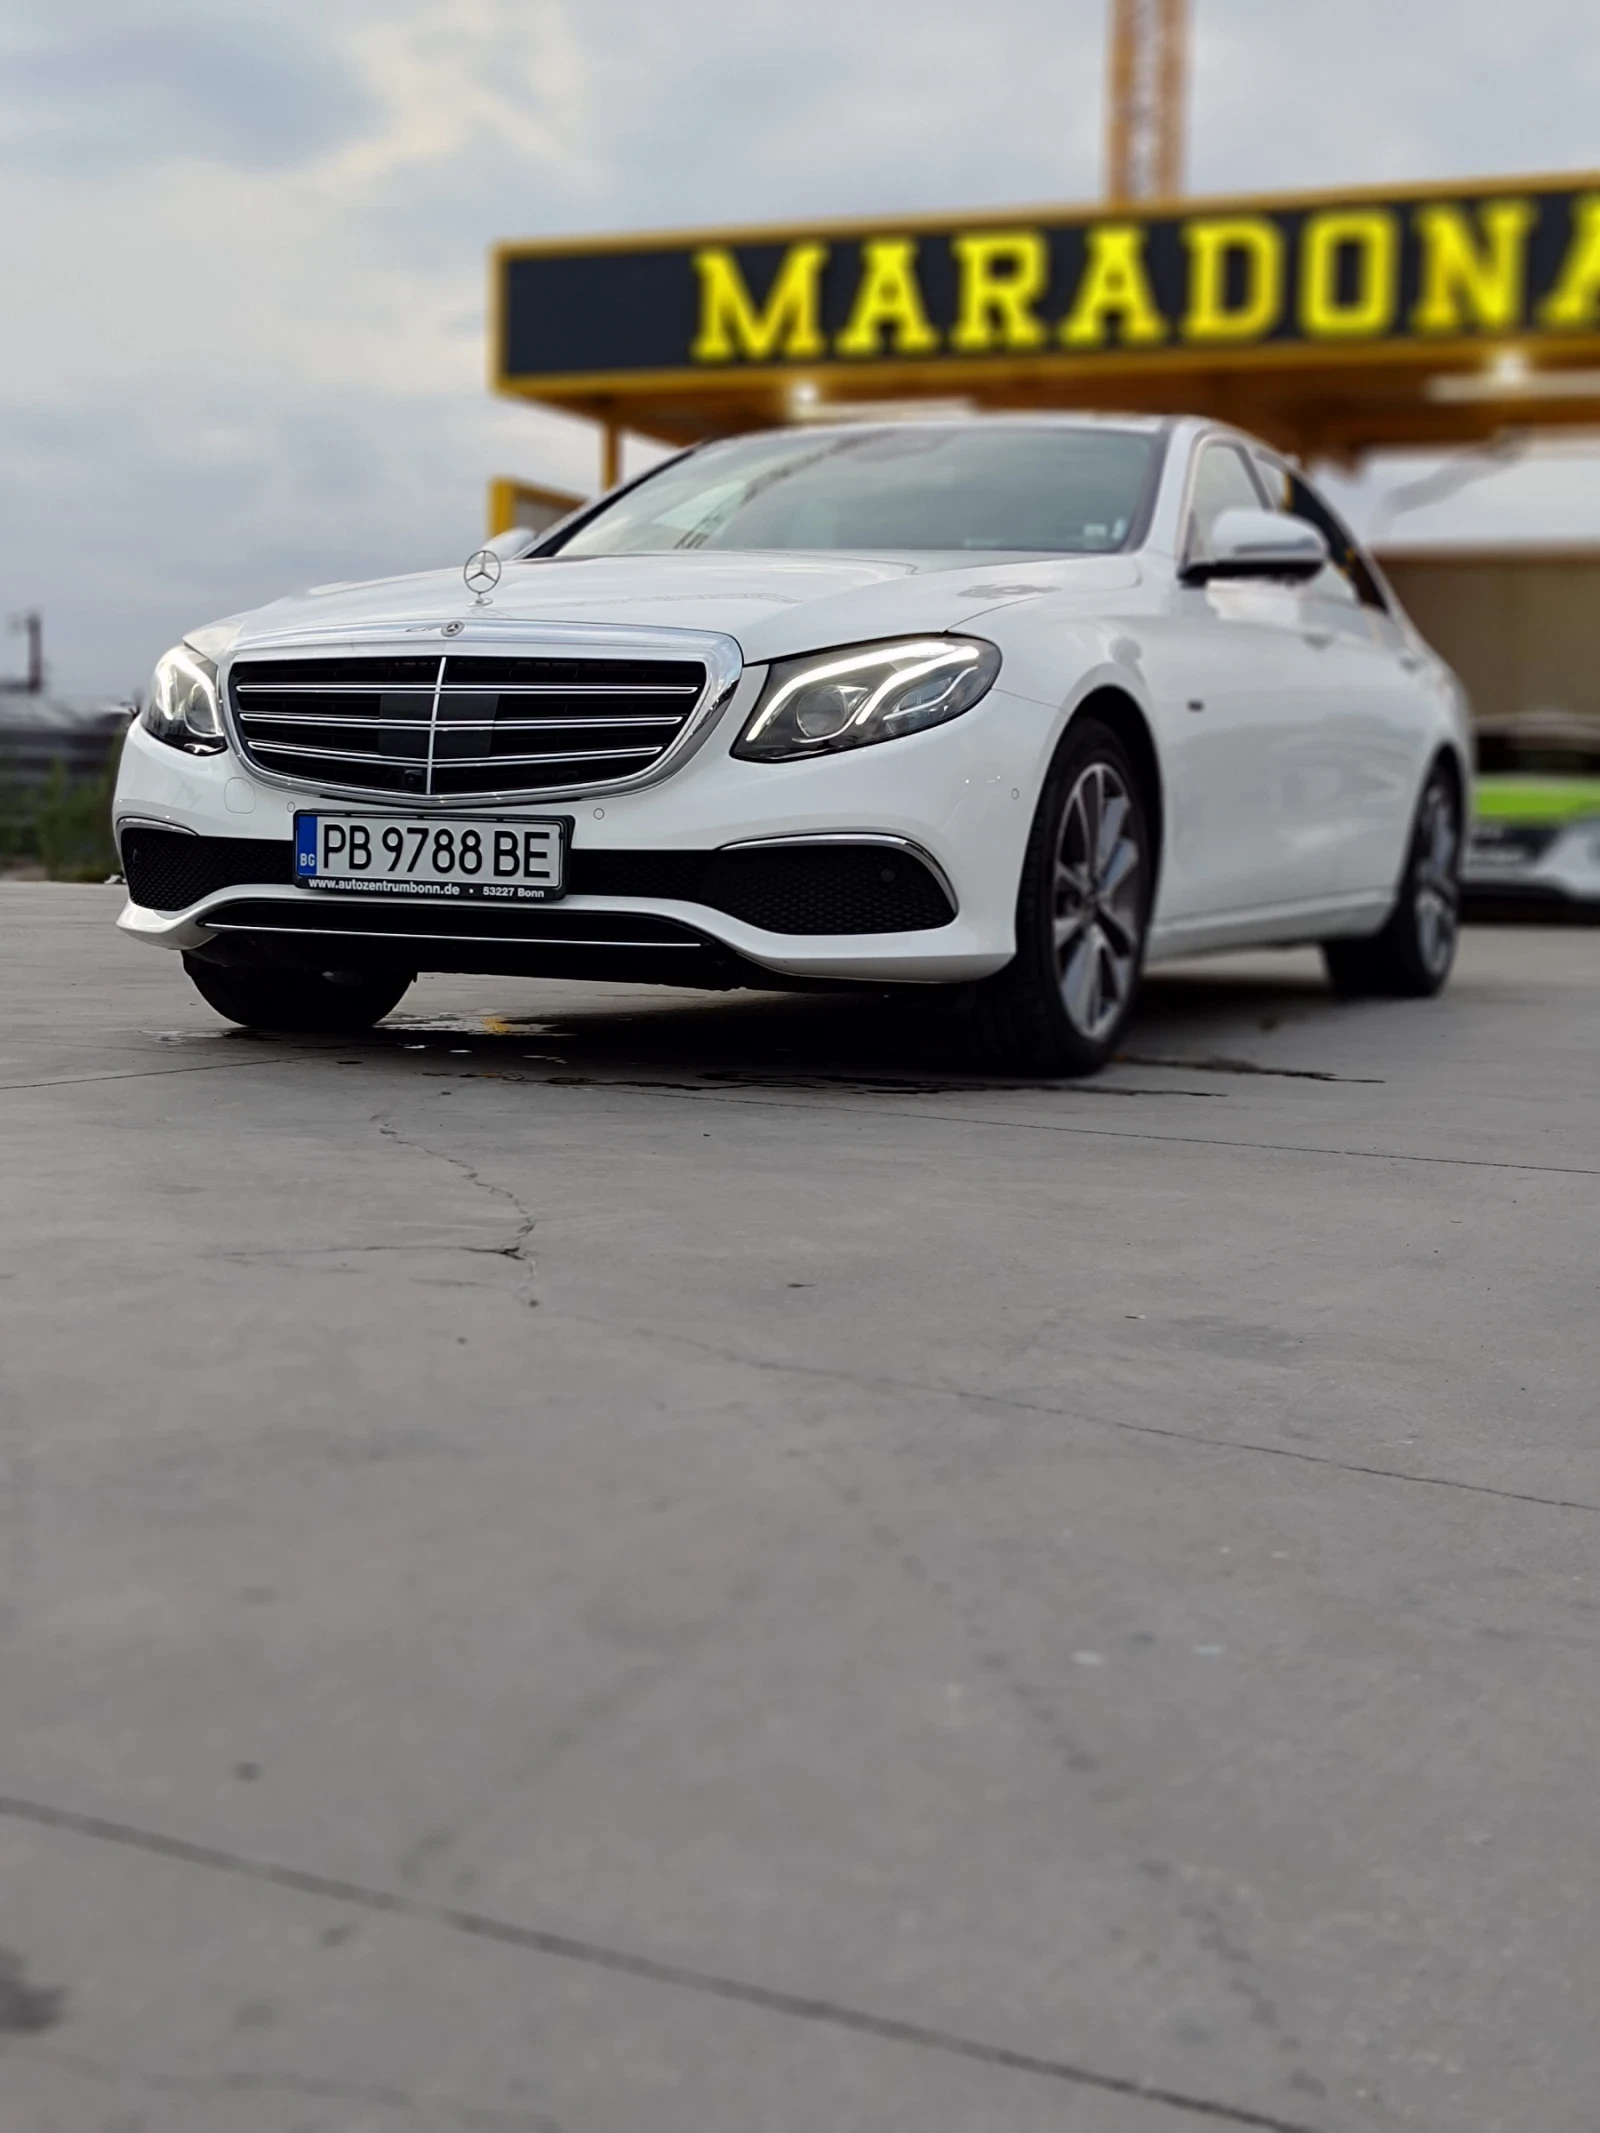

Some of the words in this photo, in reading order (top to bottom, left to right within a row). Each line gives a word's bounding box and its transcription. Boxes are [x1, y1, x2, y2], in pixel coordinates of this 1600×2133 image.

[300, 853, 316, 867] BG
[323, 824, 371, 870] PB
[381, 826, 483, 875] 9788
[493, 830, 551, 879] BE
[308, 877, 460, 895] www.autozentrumbonn.de
[483, 886, 515, 897] 53227
[517, 888, 545, 898] Bonn
